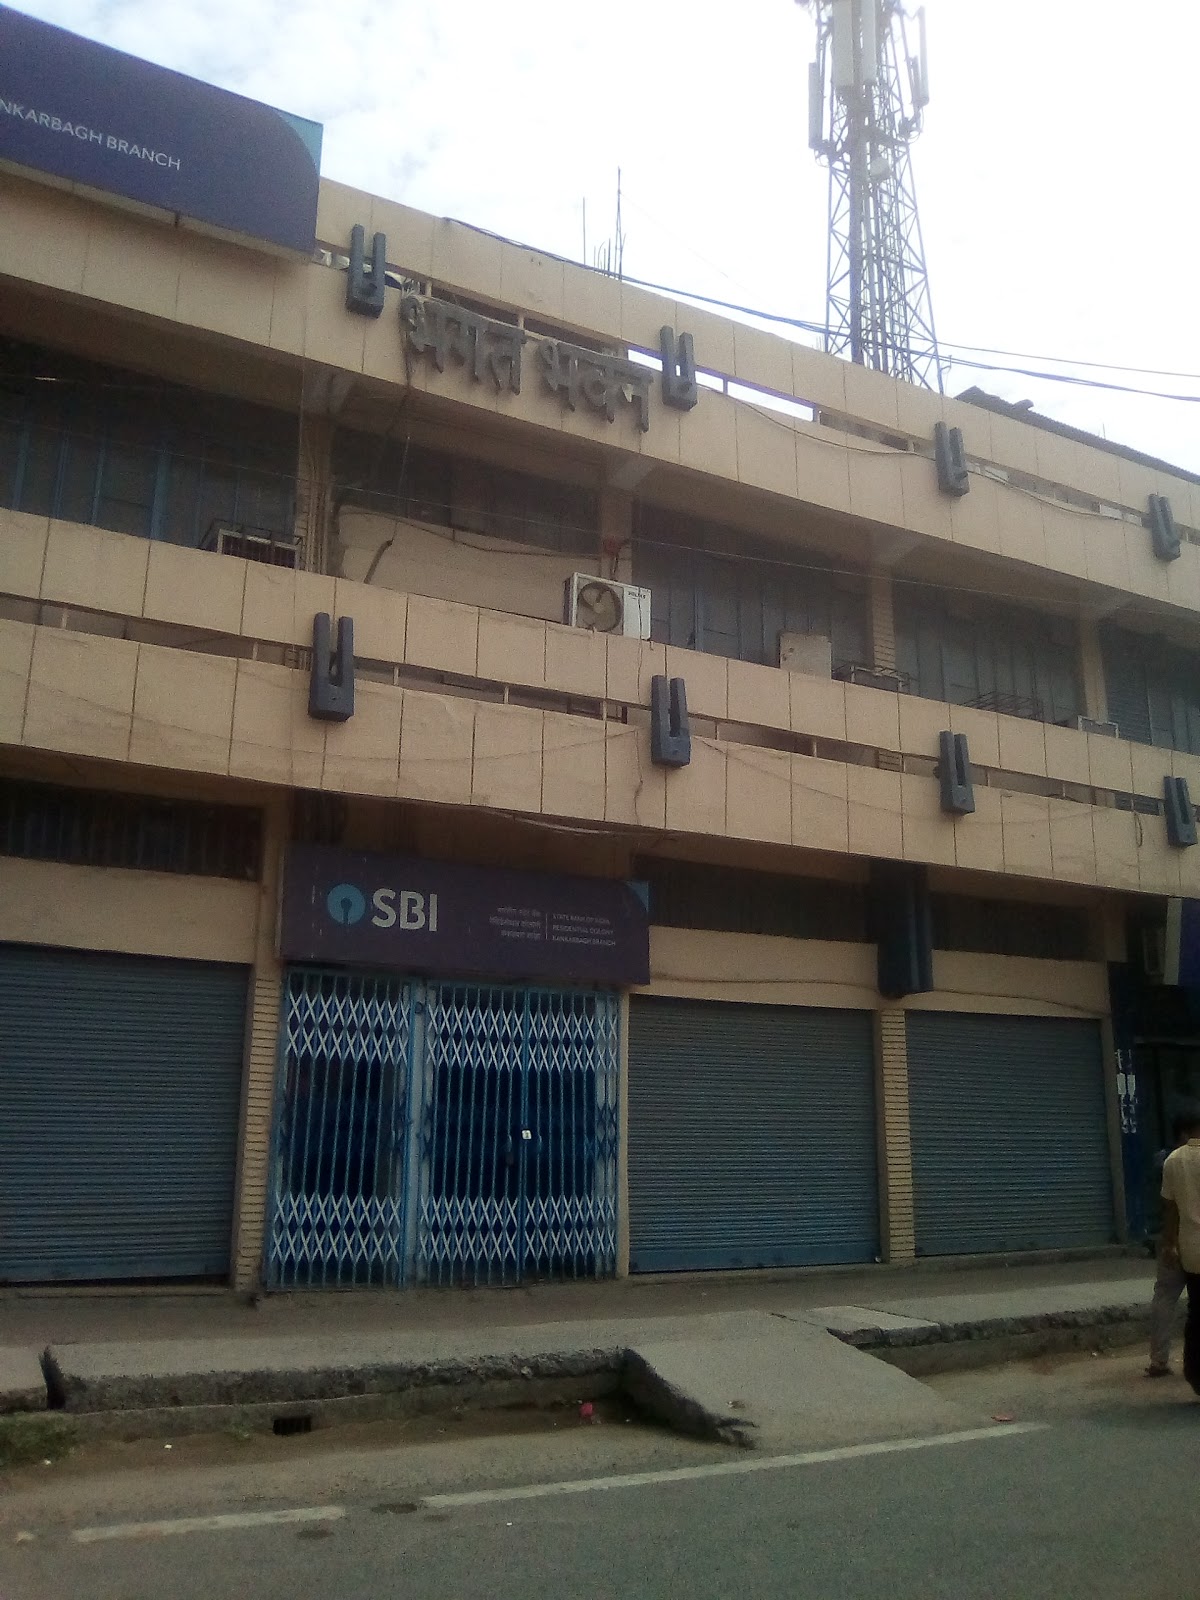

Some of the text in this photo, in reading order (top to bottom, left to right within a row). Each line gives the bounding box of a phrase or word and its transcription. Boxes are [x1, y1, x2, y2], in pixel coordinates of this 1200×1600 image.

[106, 135, 181, 171] BRANCH
[537, 337, 654, 433] भवन
[371, 888, 438, 932] SBI
